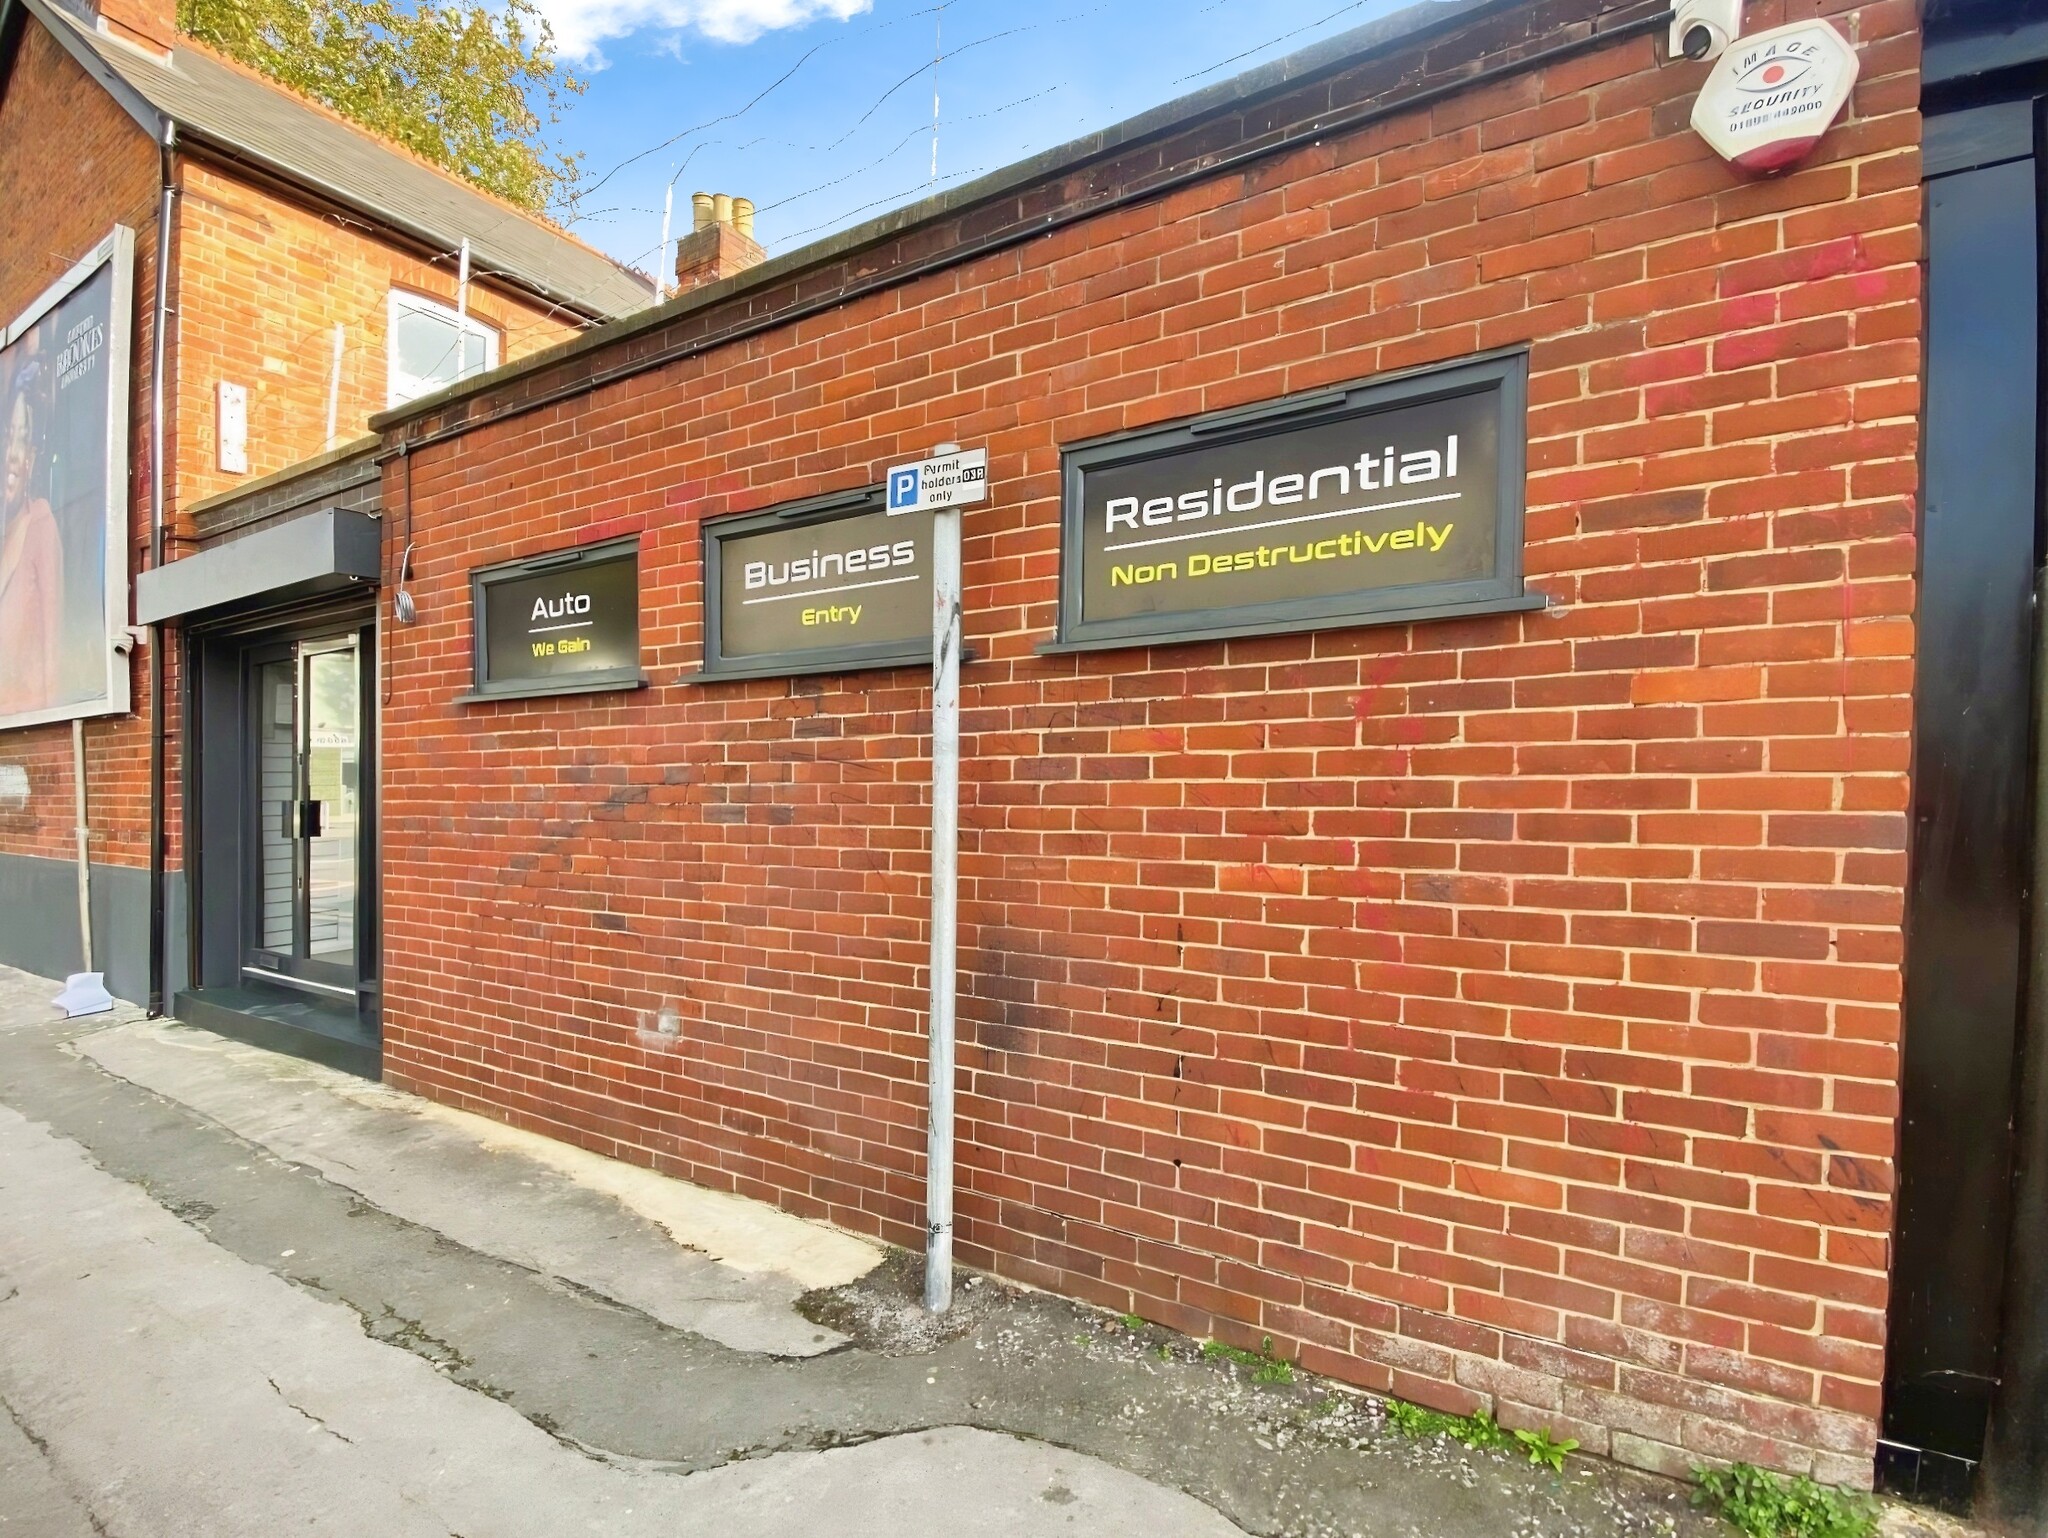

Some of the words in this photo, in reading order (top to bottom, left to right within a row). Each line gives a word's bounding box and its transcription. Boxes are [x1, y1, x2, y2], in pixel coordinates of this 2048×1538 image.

[924, 459, 960, 476] Permit
[897, 475, 914, 504] P
[921, 475, 961, 490] holders
[1105, 435, 1458, 533] Residential
[929, 490, 952, 503] only
[744, 540, 915, 590] Business
[1111, 562, 1177, 587] Non
[1187, 521, 1454, 577] Destructively
[531, 591, 591, 621] Auto
[801, 604, 862, 626] Entry
[532, 642, 555, 657] We
[557, 637, 590, 654] Gain
